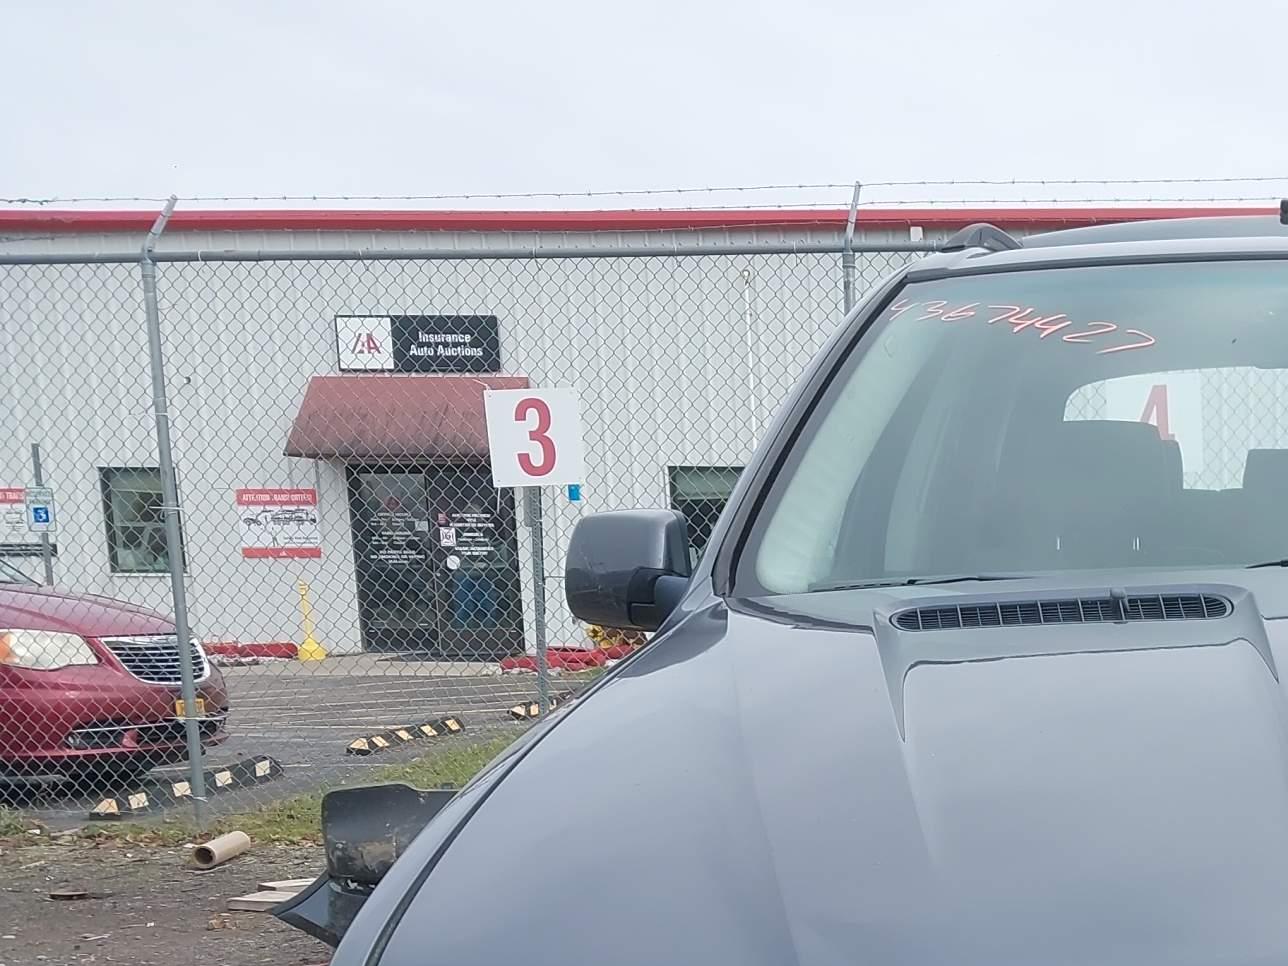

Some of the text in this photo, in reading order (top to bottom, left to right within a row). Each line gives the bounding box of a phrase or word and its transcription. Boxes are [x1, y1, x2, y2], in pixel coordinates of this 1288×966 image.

[418, 331, 471, 343] Insurance
[889, 299, 1155, 354] 43674427
[409, 344, 483, 357] Auto Auctions
[514, 397, 556, 477] 3
